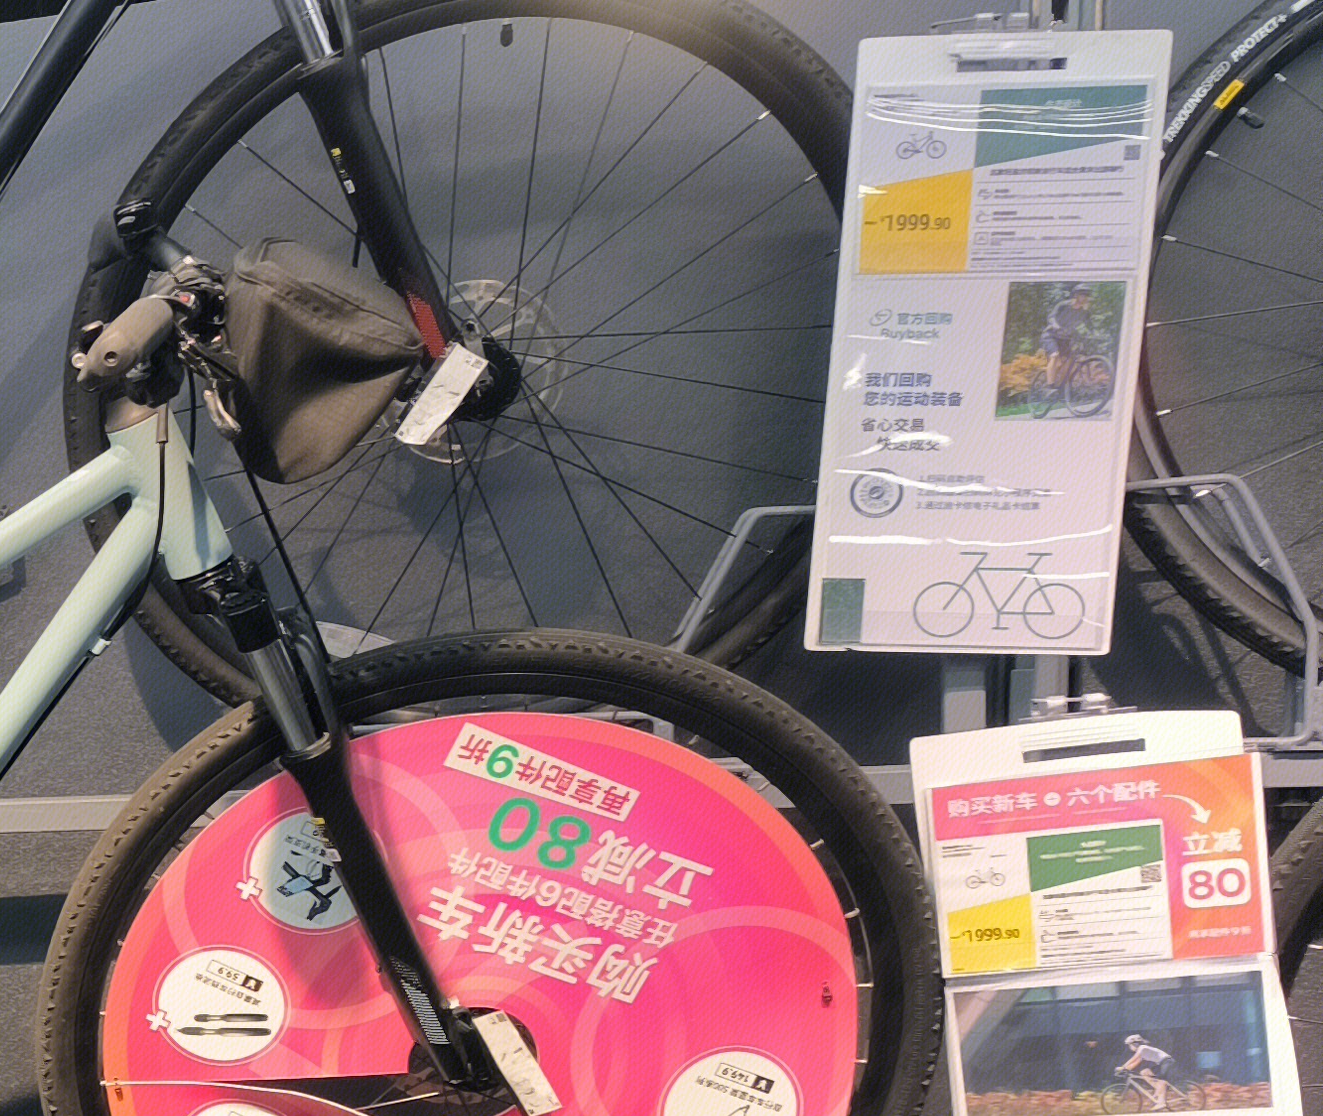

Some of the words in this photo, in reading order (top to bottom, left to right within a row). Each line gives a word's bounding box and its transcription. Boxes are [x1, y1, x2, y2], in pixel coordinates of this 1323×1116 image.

[1231, 14, 1287, 62] PROTECT+
[896, 312, 954, 326] 官方回购
[864, 372, 932, 388] 我们回购
[863, 391, 964, 407] 您的运动装备
[861, 418, 925, 432] 省心交易
[947, 791, 1038, 818] 购买新车
[1066, 780, 1161, 806] 六个配件
[1181, 828, 1244, 857] 立减
[447, 846, 679, 949] 任意搭配6件配件
[1187, 867, 1247, 901] 80
[416, 884, 659, 1004] 购买新车
[721, 1066, 750, 1083] 149.9
